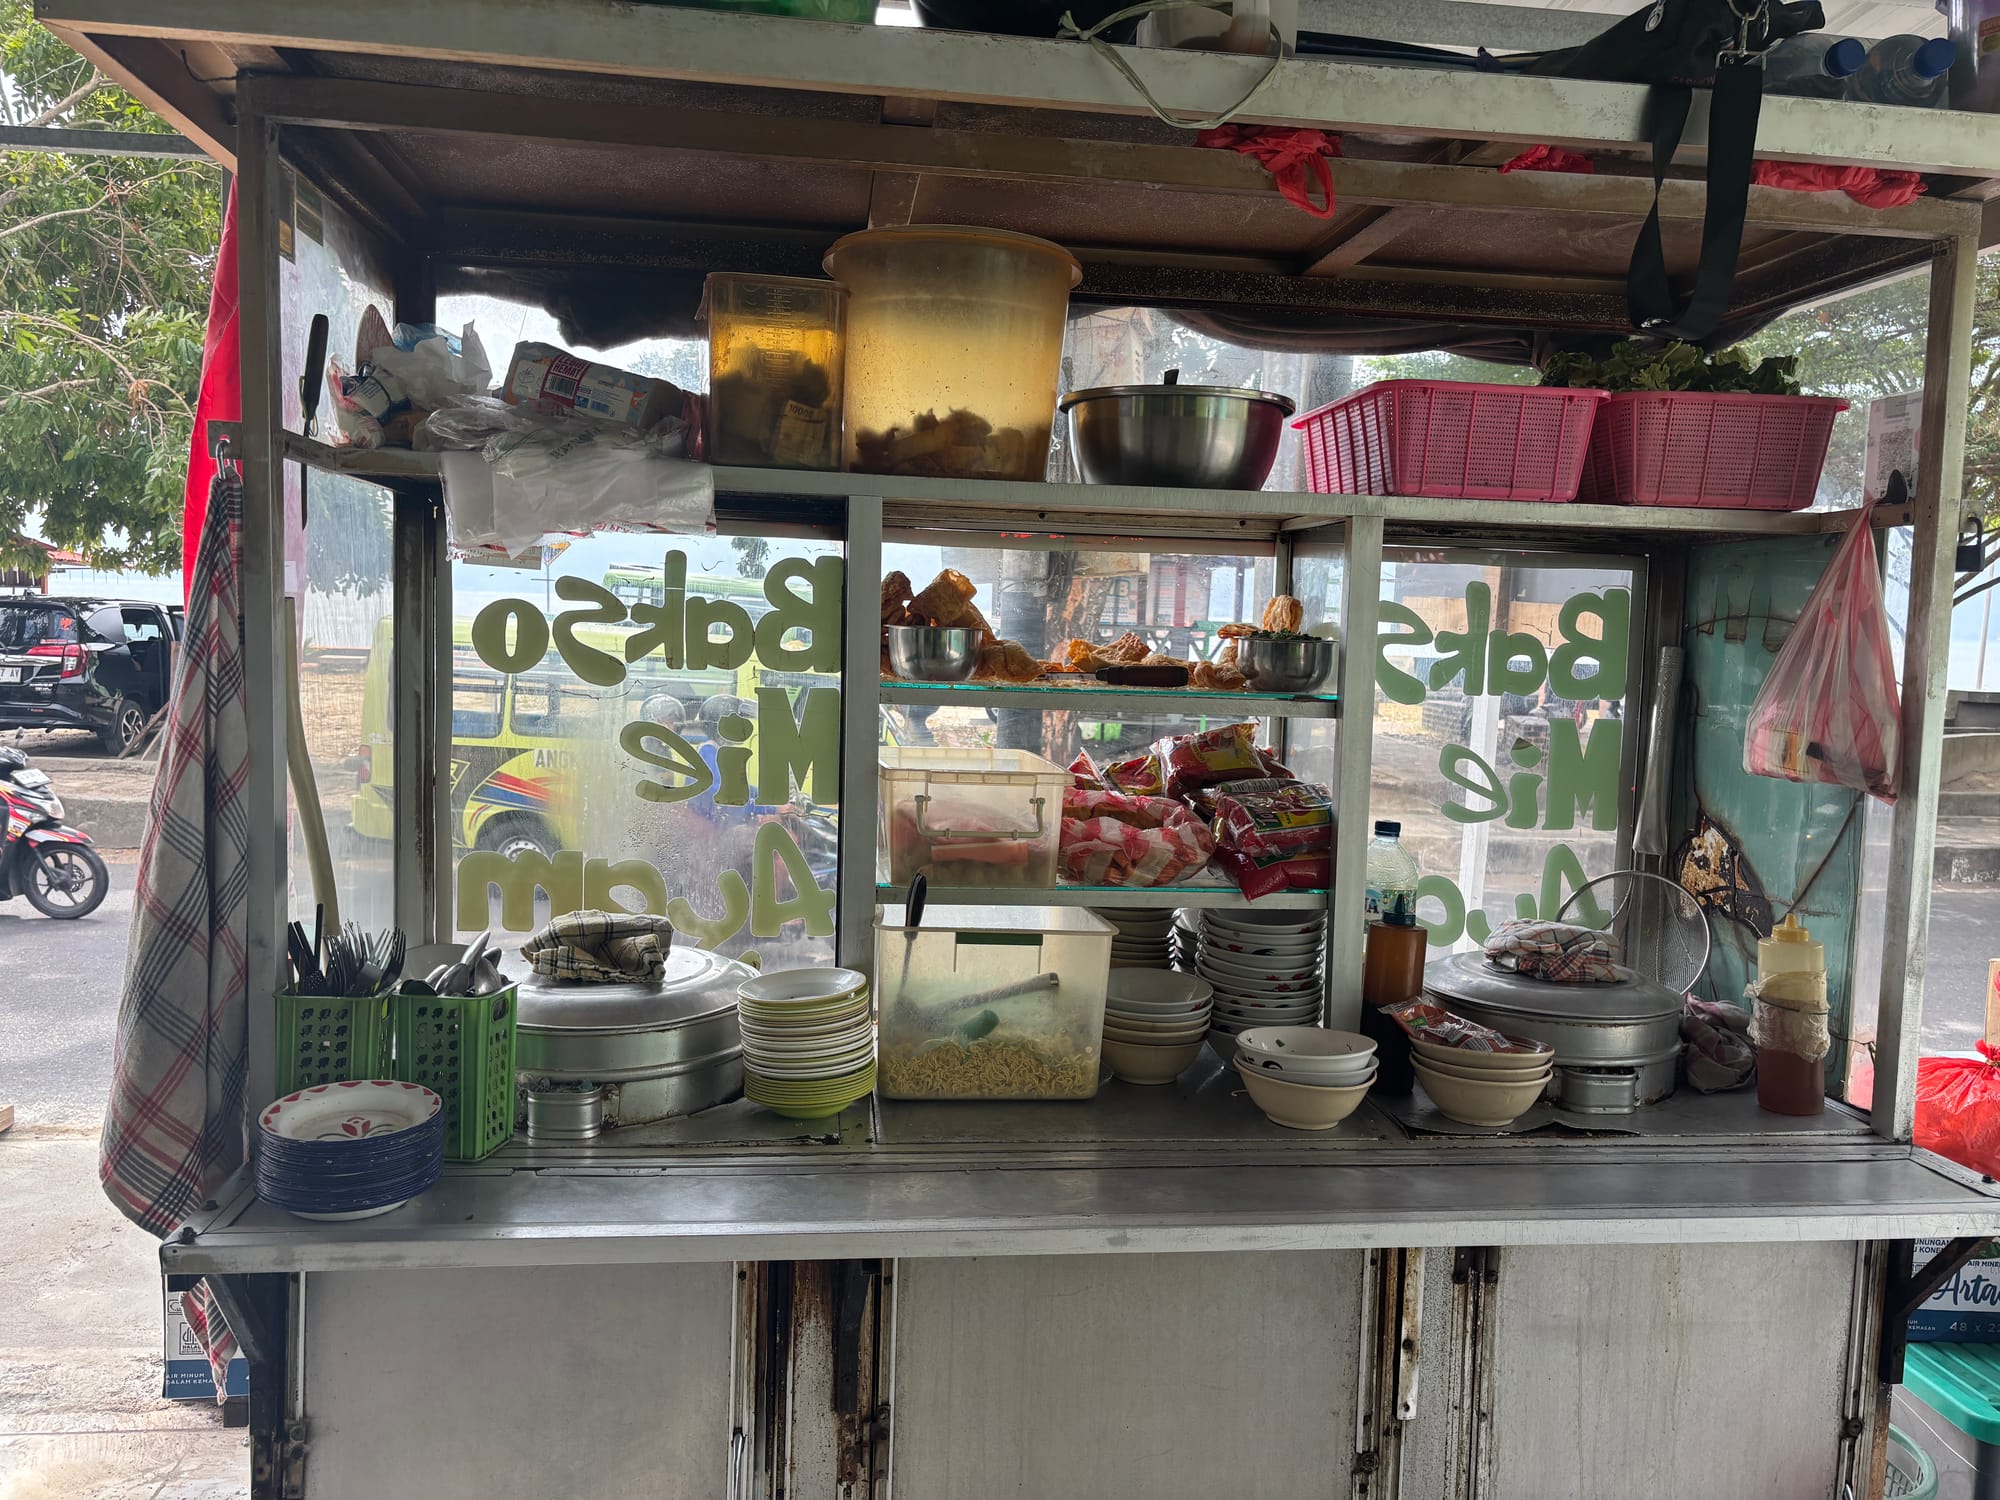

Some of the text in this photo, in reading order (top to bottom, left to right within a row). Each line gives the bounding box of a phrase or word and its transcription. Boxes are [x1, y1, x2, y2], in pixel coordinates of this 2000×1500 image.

[552, 362, 582, 378] HEMAT
[1920, 1246, 1942, 1254] KONE
[1932, 1269, 2000, 1306] Arta
[1949, 1321, 1967, 1332] 48
